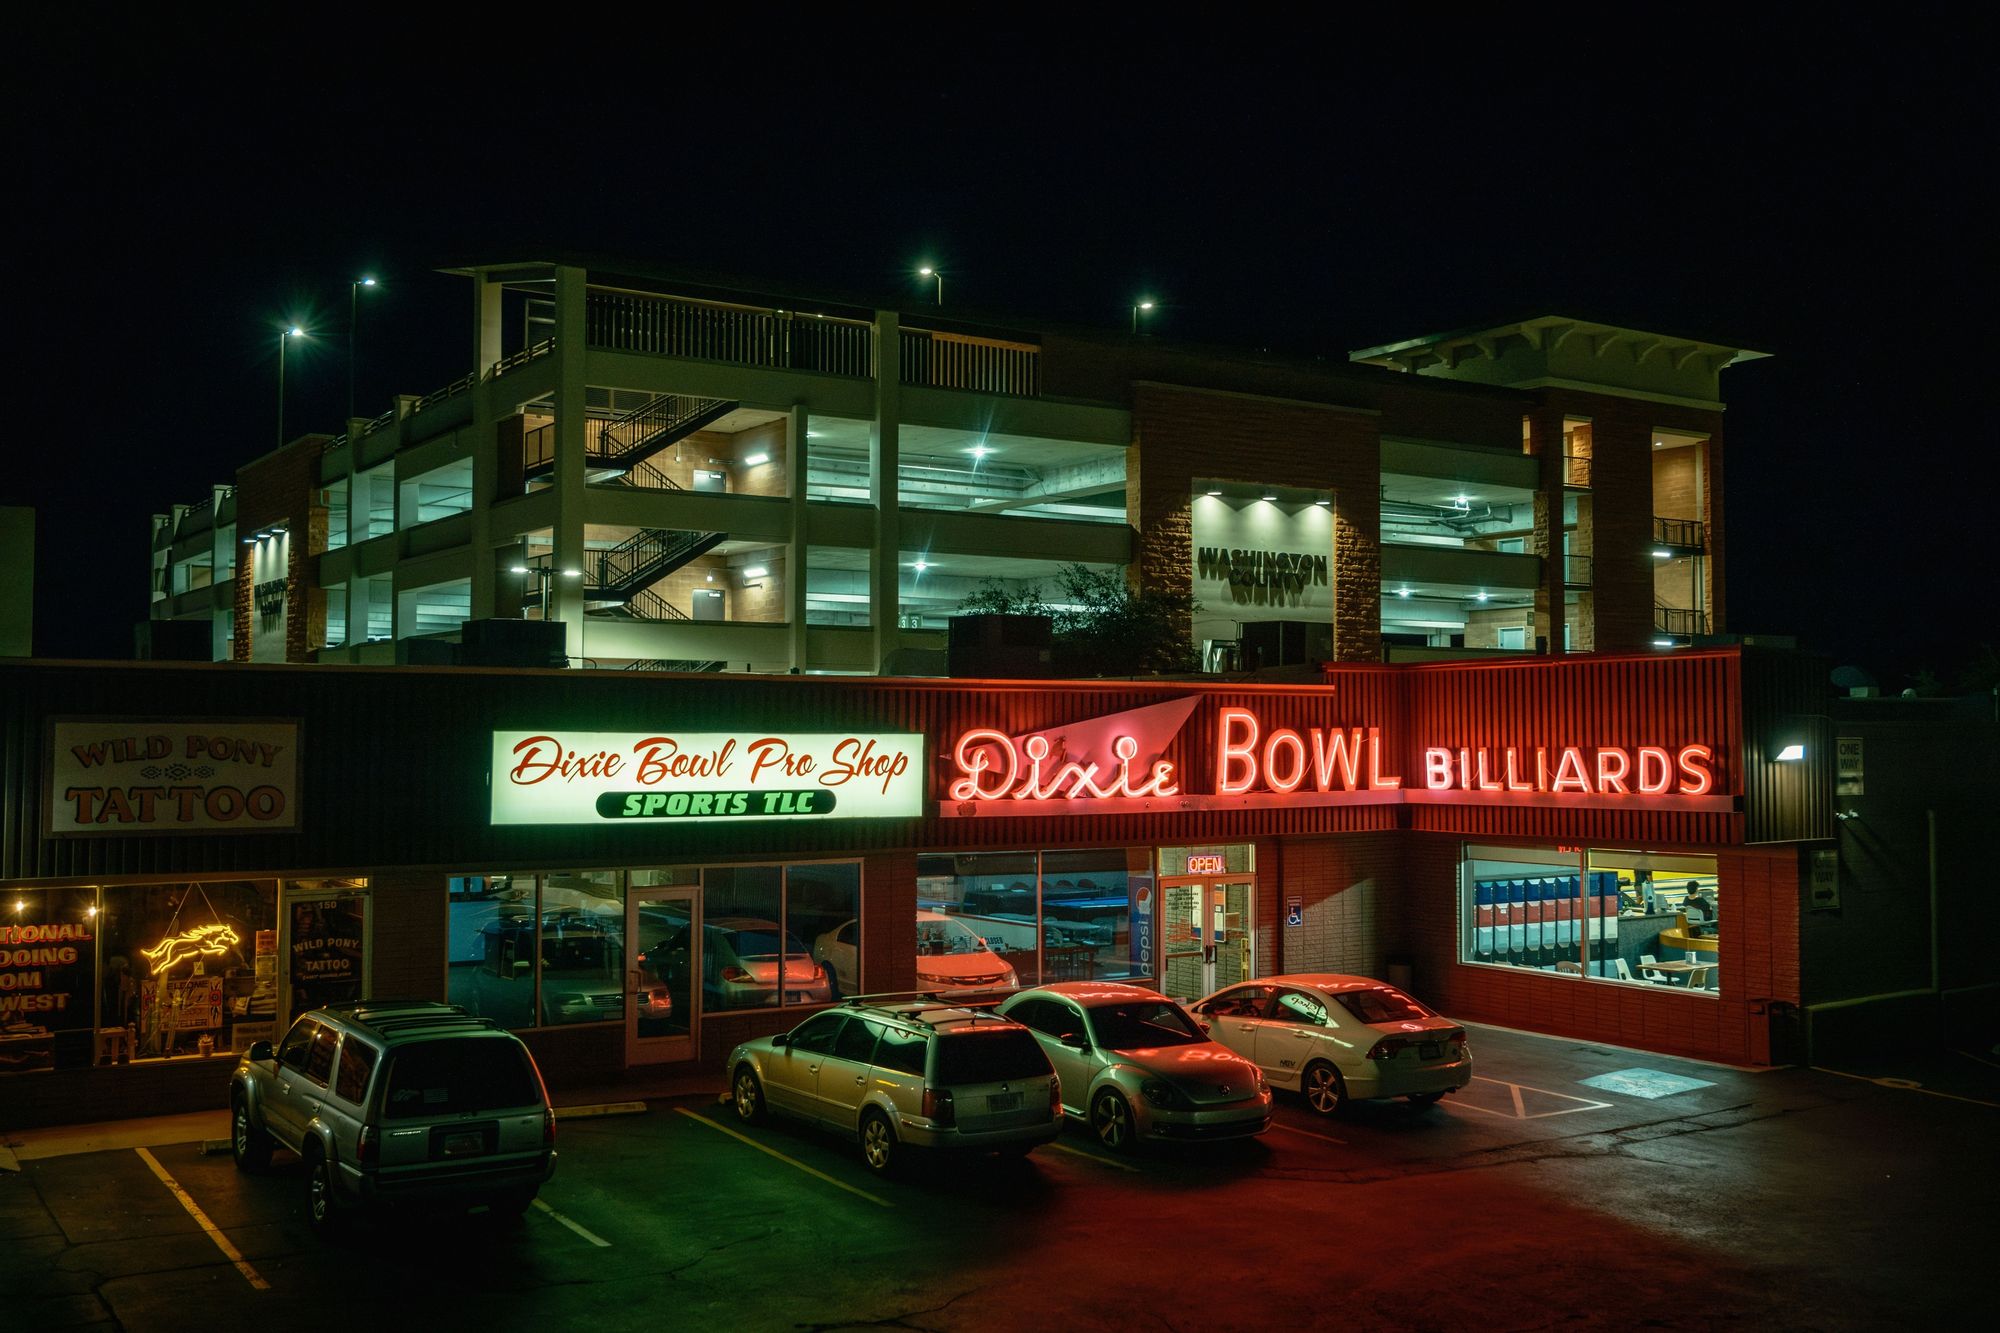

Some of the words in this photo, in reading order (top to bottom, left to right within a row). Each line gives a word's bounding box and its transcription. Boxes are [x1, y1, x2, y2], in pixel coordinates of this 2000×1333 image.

[1198, 547, 1327, 572] WASHINGTON
[1229, 568, 1305, 594] COUNTY
[911, 619, 918, 629] 3
[71, 735, 173, 768] WILD
[186, 735, 284, 768] PONY
[949, 728, 1180, 801] Dixie
[1216, 707, 1402, 795] BOWL
[1839, 744, 1860, 756] ONE
[510, 735, 627, 786] Dixie
[633, 738, 738, 786] Bowl
[747, 737, 817, 784] Pro
[818, 738, 909, 795] Shop
[1424, 745, 1715, 796] BILLIARDS
[1839, 759, 1859, 770] WAY
[65, 785, 287, 824] TATTOO
[622, 792, 749, 817] SPORTS
[763, 790, 816, 814] TLC
[1189, 857, 1221, 872] OPEN
[1814, 872, 1834, 883] WAY
[319, 901, 337, 909] 150
[293, 939, 324, 952] WILD
[327, 938, 359, 949] PONY
[1138, 920, 1152, 976] pepsi
[305, 959, 350, 971] TATTOO
